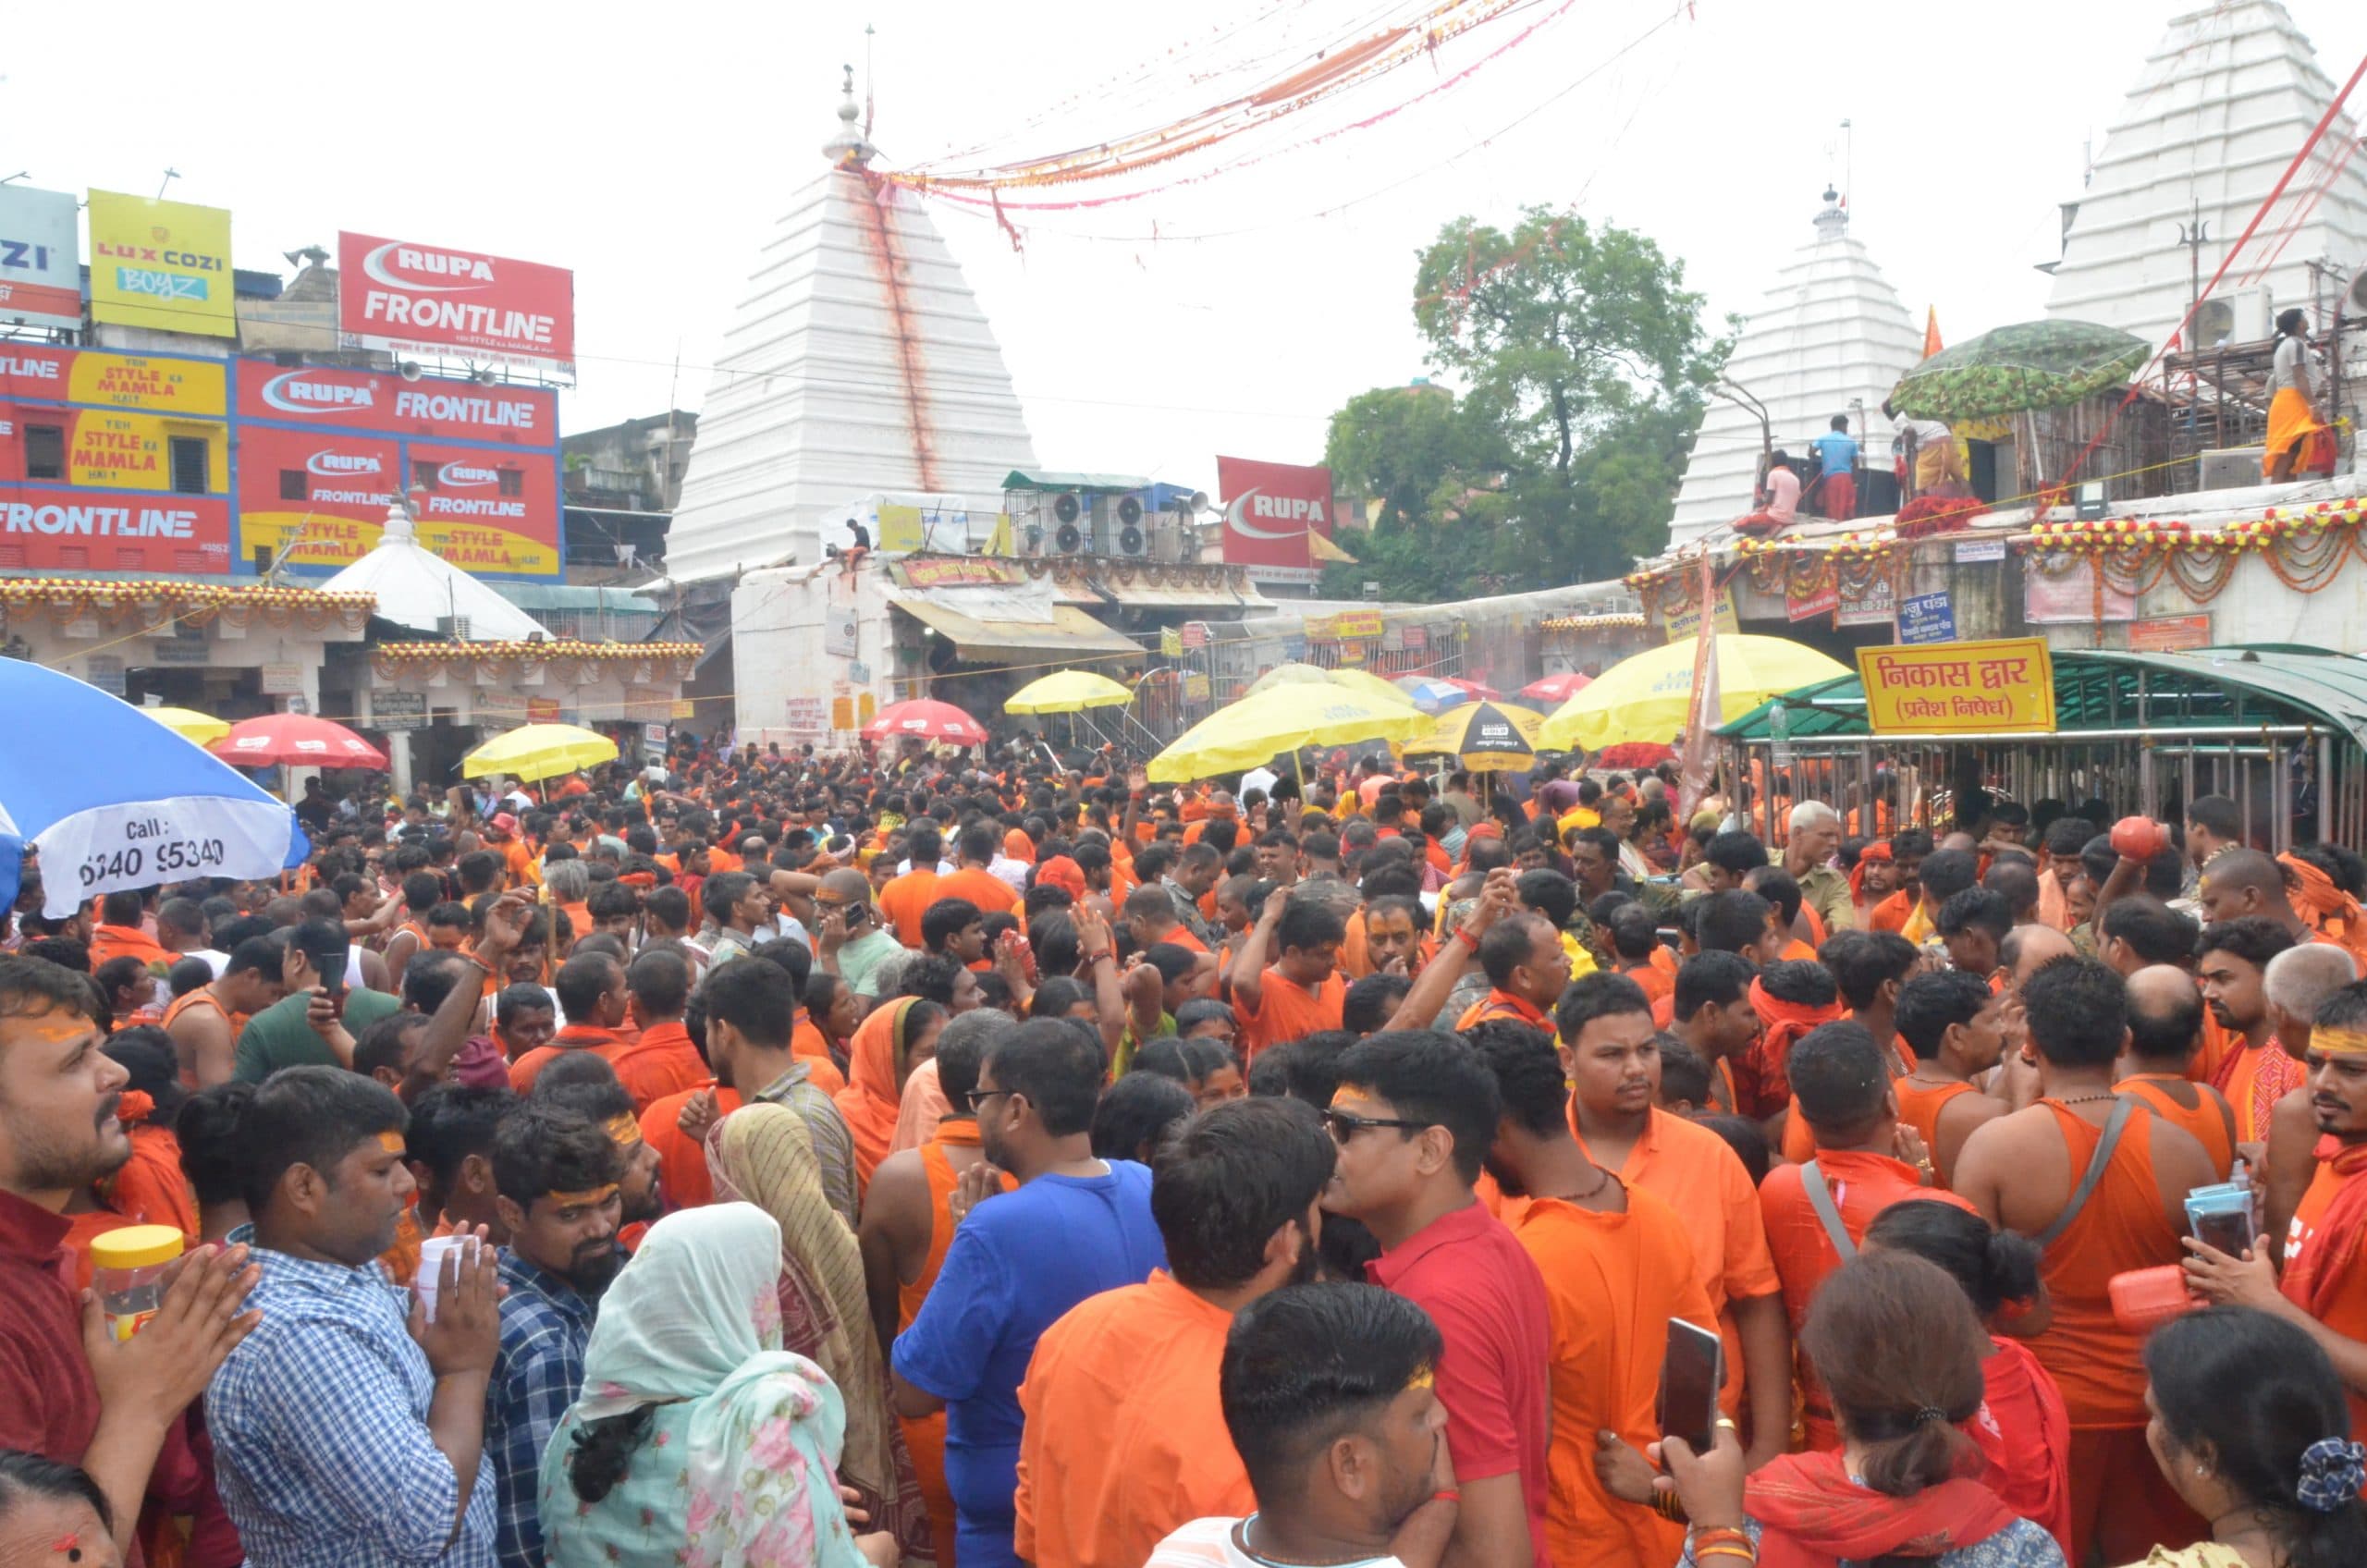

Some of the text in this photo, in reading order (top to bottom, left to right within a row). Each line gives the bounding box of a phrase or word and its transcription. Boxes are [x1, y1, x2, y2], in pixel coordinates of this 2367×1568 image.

[164, 251, 223, 272] COZI
[398, 247, 494, 282] RUPA
[364, 289, 555, 343] FRONTLINE
[106, 367, 160, 382] STYLE
[97, 379, 176, 397] MAMLA
[288, 381, 534, 428] RUPA FRONTLINE
[85, 431, 141, 450] STYLE
[74, 450, 156, 471] MAMLA
[323, 454, 381, 472] RUPA
[451, 467, 499, 482] RUPA
[313, 488, 393, 507] FRONTLINE
[428, 496, 525, 518] FRONTLINE
[1254, 495, 1324, 521] RUPA
[451, 529, 503, 545] STYLE
[444, 546, 510, 563] MAMLA
[1877, 655, 2029, 689] निकास द्वार
[1896, 692, 2013, 721] (प्रवेश निषेध)
